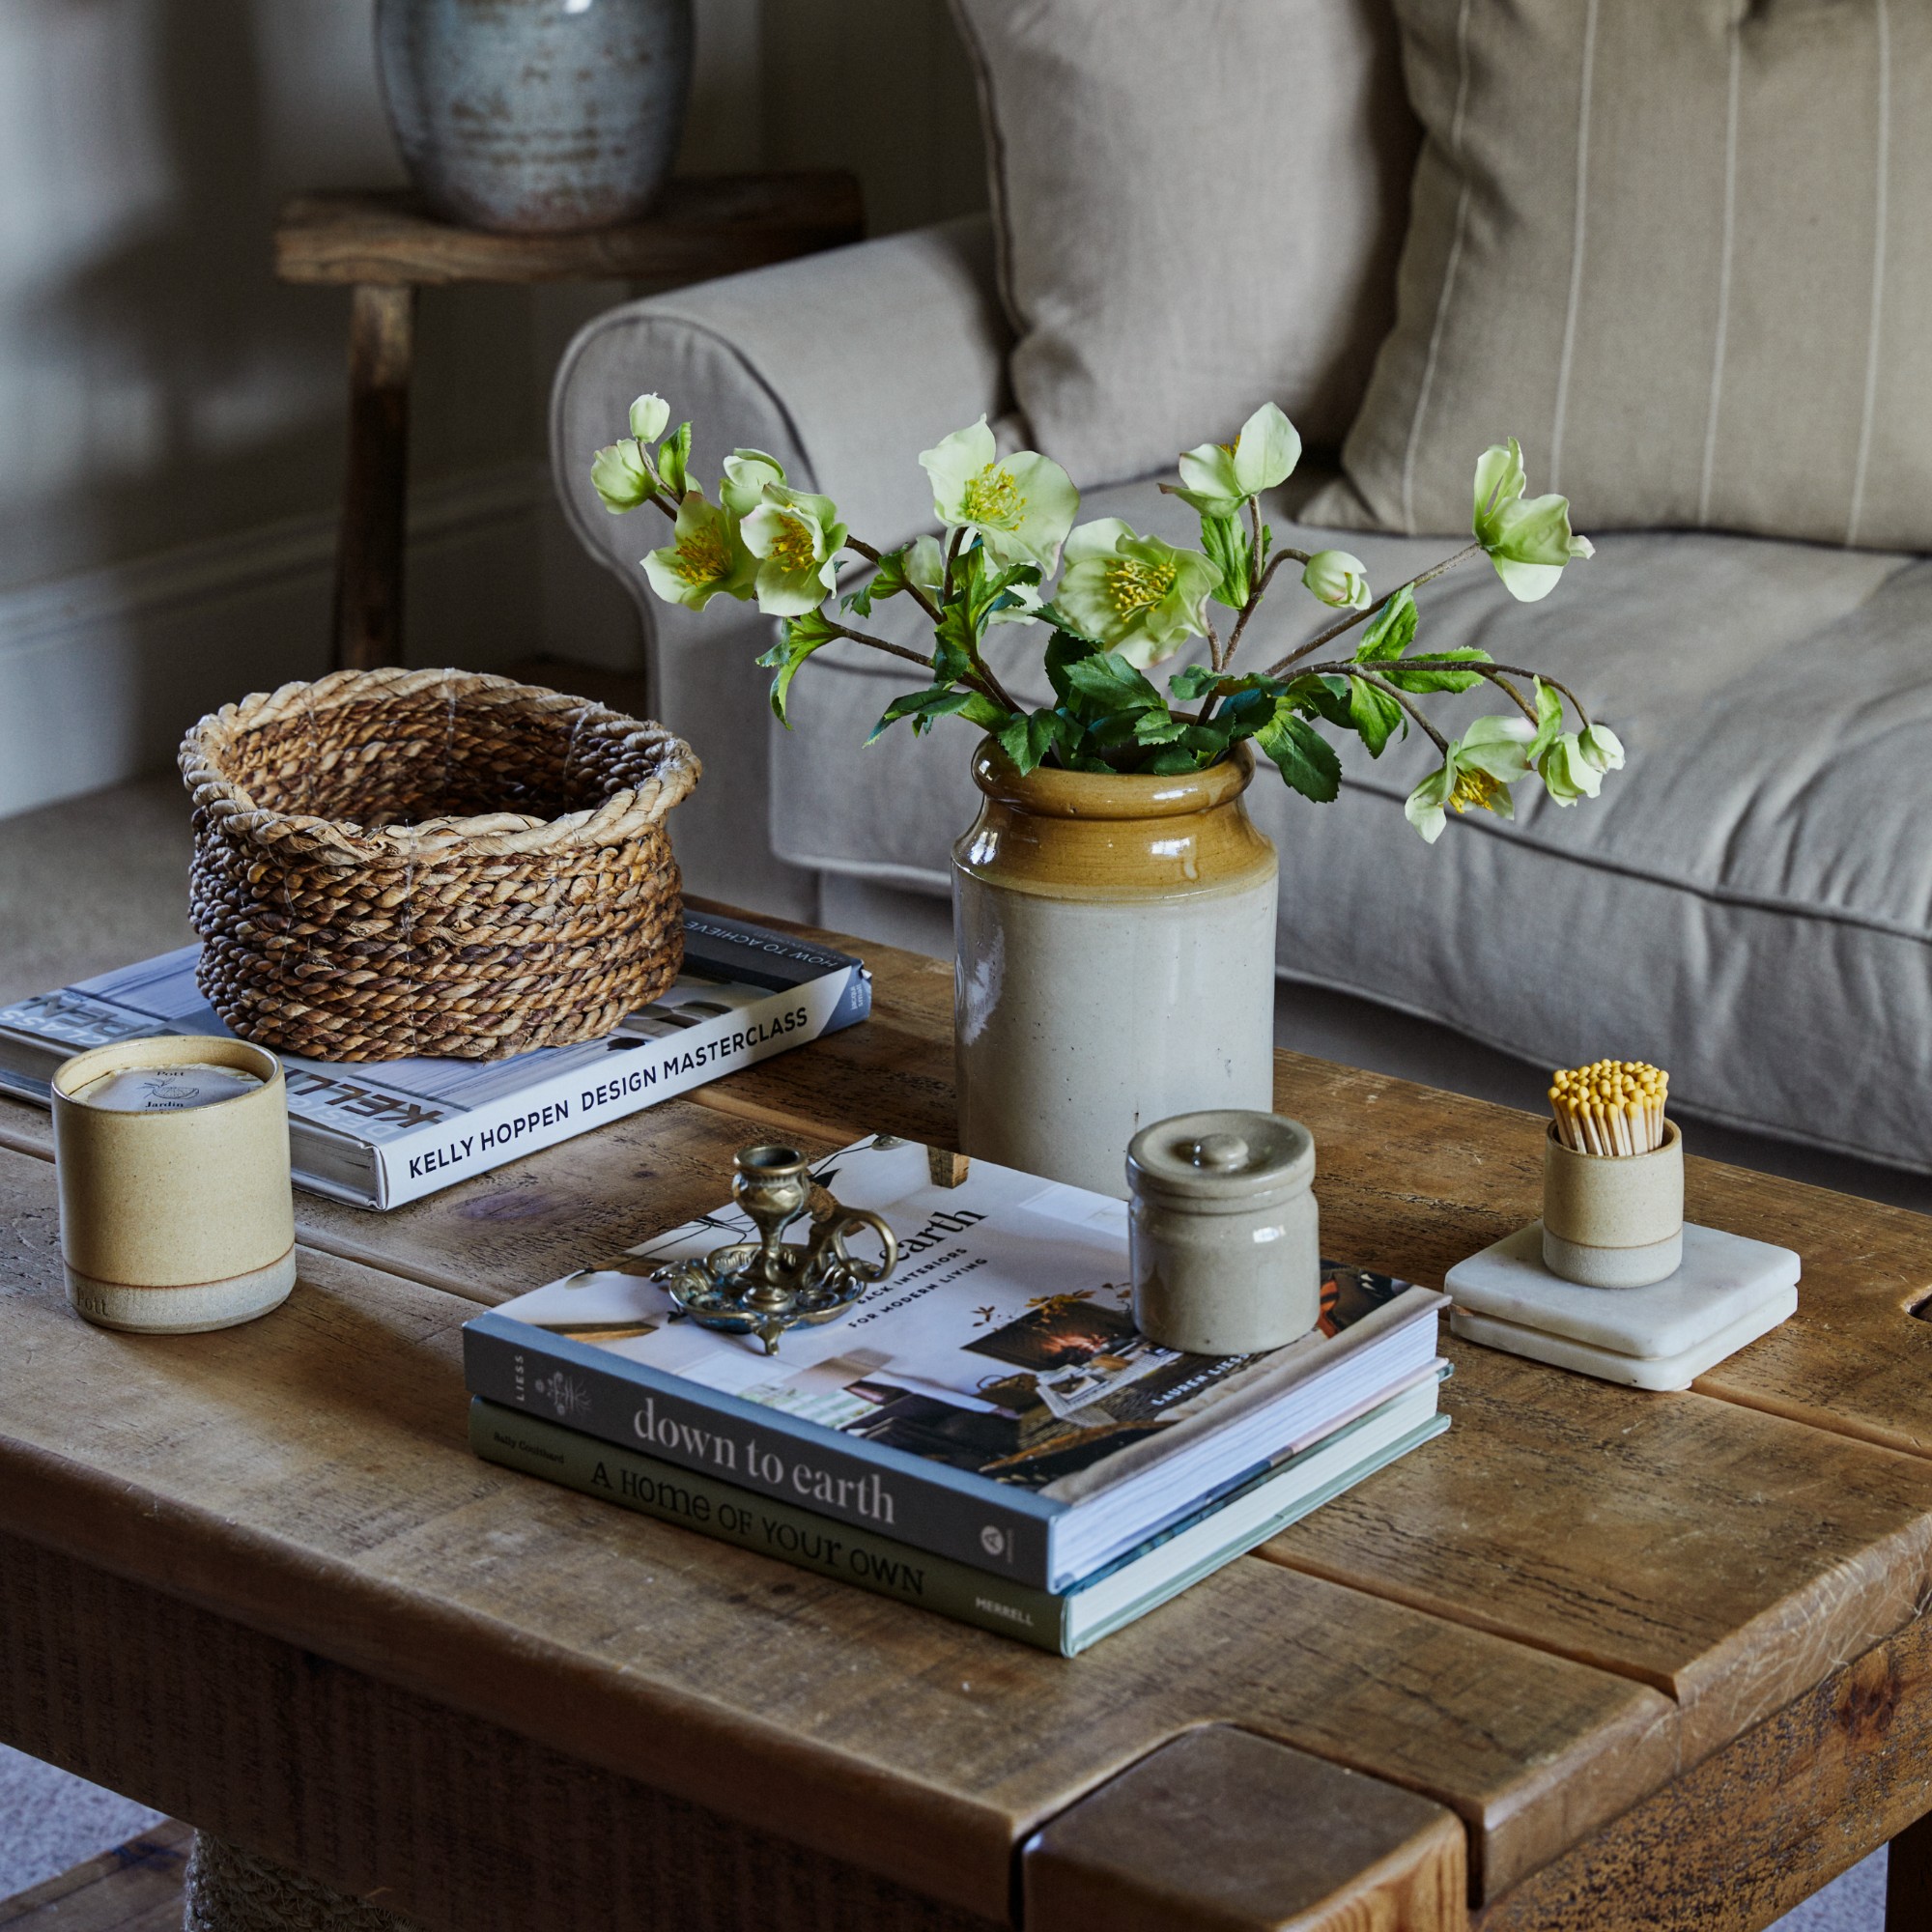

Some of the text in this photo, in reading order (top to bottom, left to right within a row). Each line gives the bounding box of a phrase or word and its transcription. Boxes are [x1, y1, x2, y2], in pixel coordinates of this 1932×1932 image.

[684, 921, 763, 947] ACHIEVE
[762, 943, 788, 955] TO
[789, 951, 838, 967] HOW
[286, 1068, 444, 1128] KELL
[409, 1007, 808, 1179] KELLY HOPPEN DESIGN MASTERCLASS
[288, 1097, 400, 1138] DESIG
[894, 1247, 968, 1286] INTERIORS
[76, 1286, 109, 1318] Pott
[848, 1258, 988, 1328] FOR MODERN LIVING
[515, 1354, 525, 1402] LIESS
[1151, 1375, 1208, 1406] LAUREN
[634, 1397, 895, 1524] down to earth
[590, 1461, 613, 1491] A
[718, 1502, 753, 1537] OF
[849, 1548, 924, 1596] OWN
[975, 1596, 1035, 1627] MERRELL
